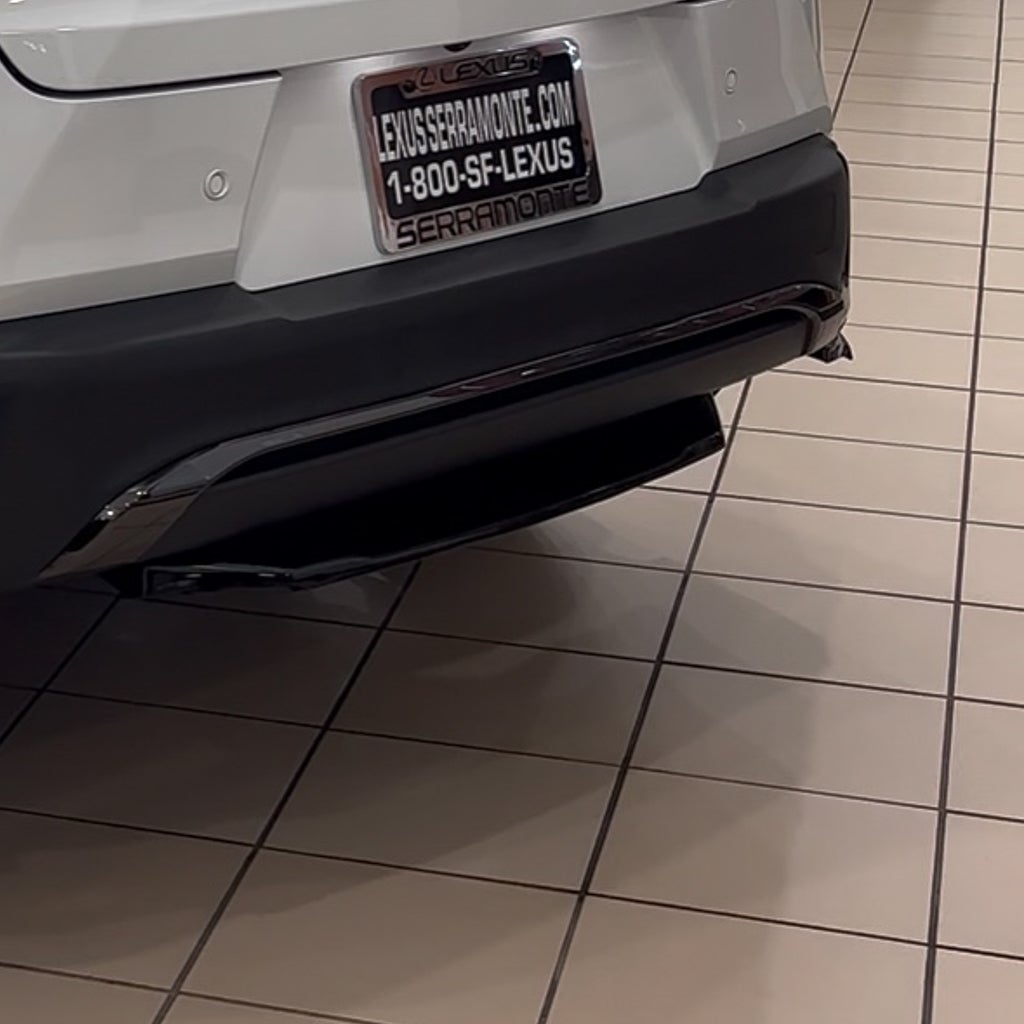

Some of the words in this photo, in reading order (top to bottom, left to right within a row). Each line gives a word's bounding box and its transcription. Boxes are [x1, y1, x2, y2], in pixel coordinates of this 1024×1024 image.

[439, 52, 529, 85] LEXUS
[387, 136, 574, 205] 1-800-SF-LEXUS
[396, 178, 593, 249] SERRAMONTE
